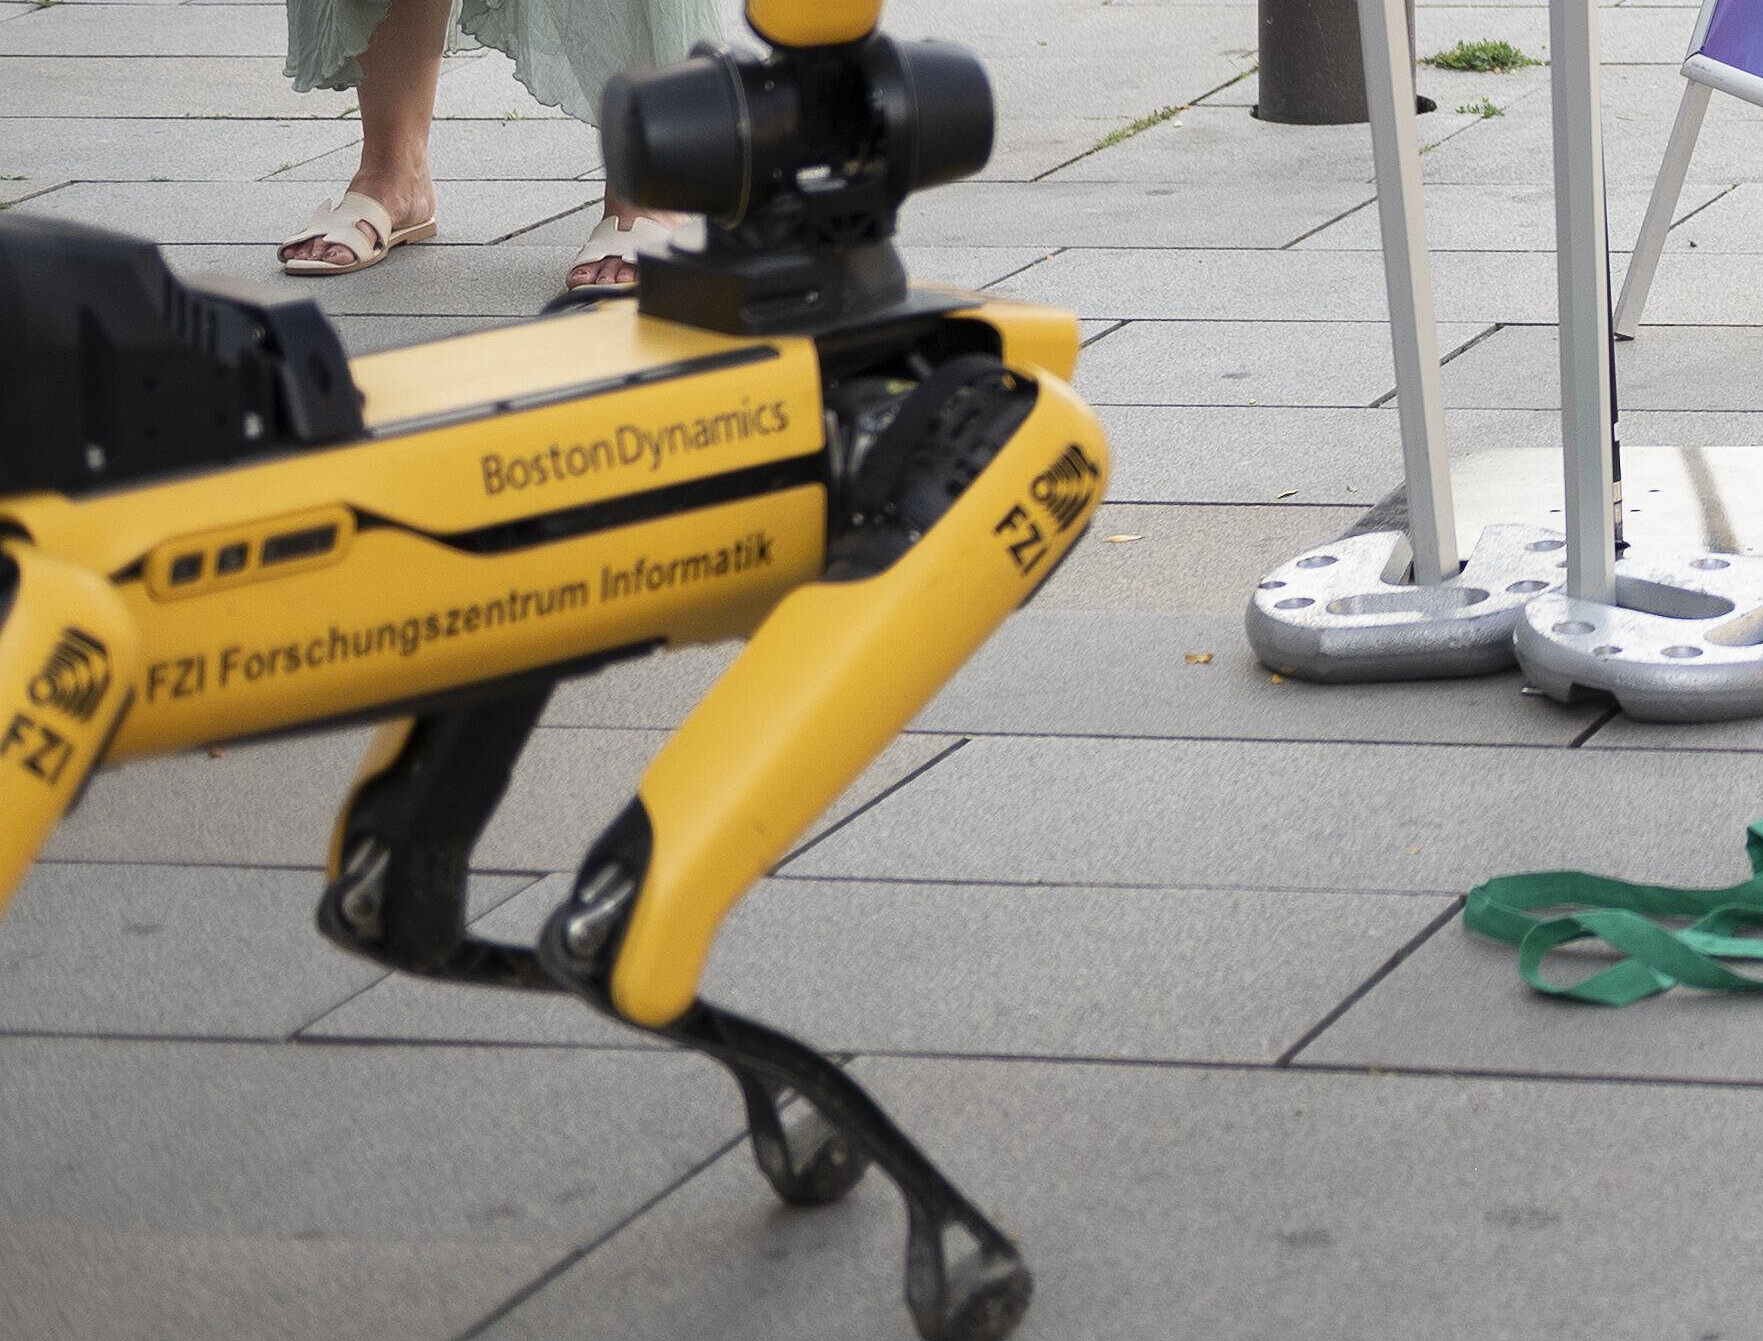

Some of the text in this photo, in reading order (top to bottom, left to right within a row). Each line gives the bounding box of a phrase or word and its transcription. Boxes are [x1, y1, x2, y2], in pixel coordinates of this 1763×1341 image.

[994, 503, 1048, 577] FZI
[146, 531, 774, 705] FZI Forschungszentrum Informatik
[0, 712, 75, 787] FZI
